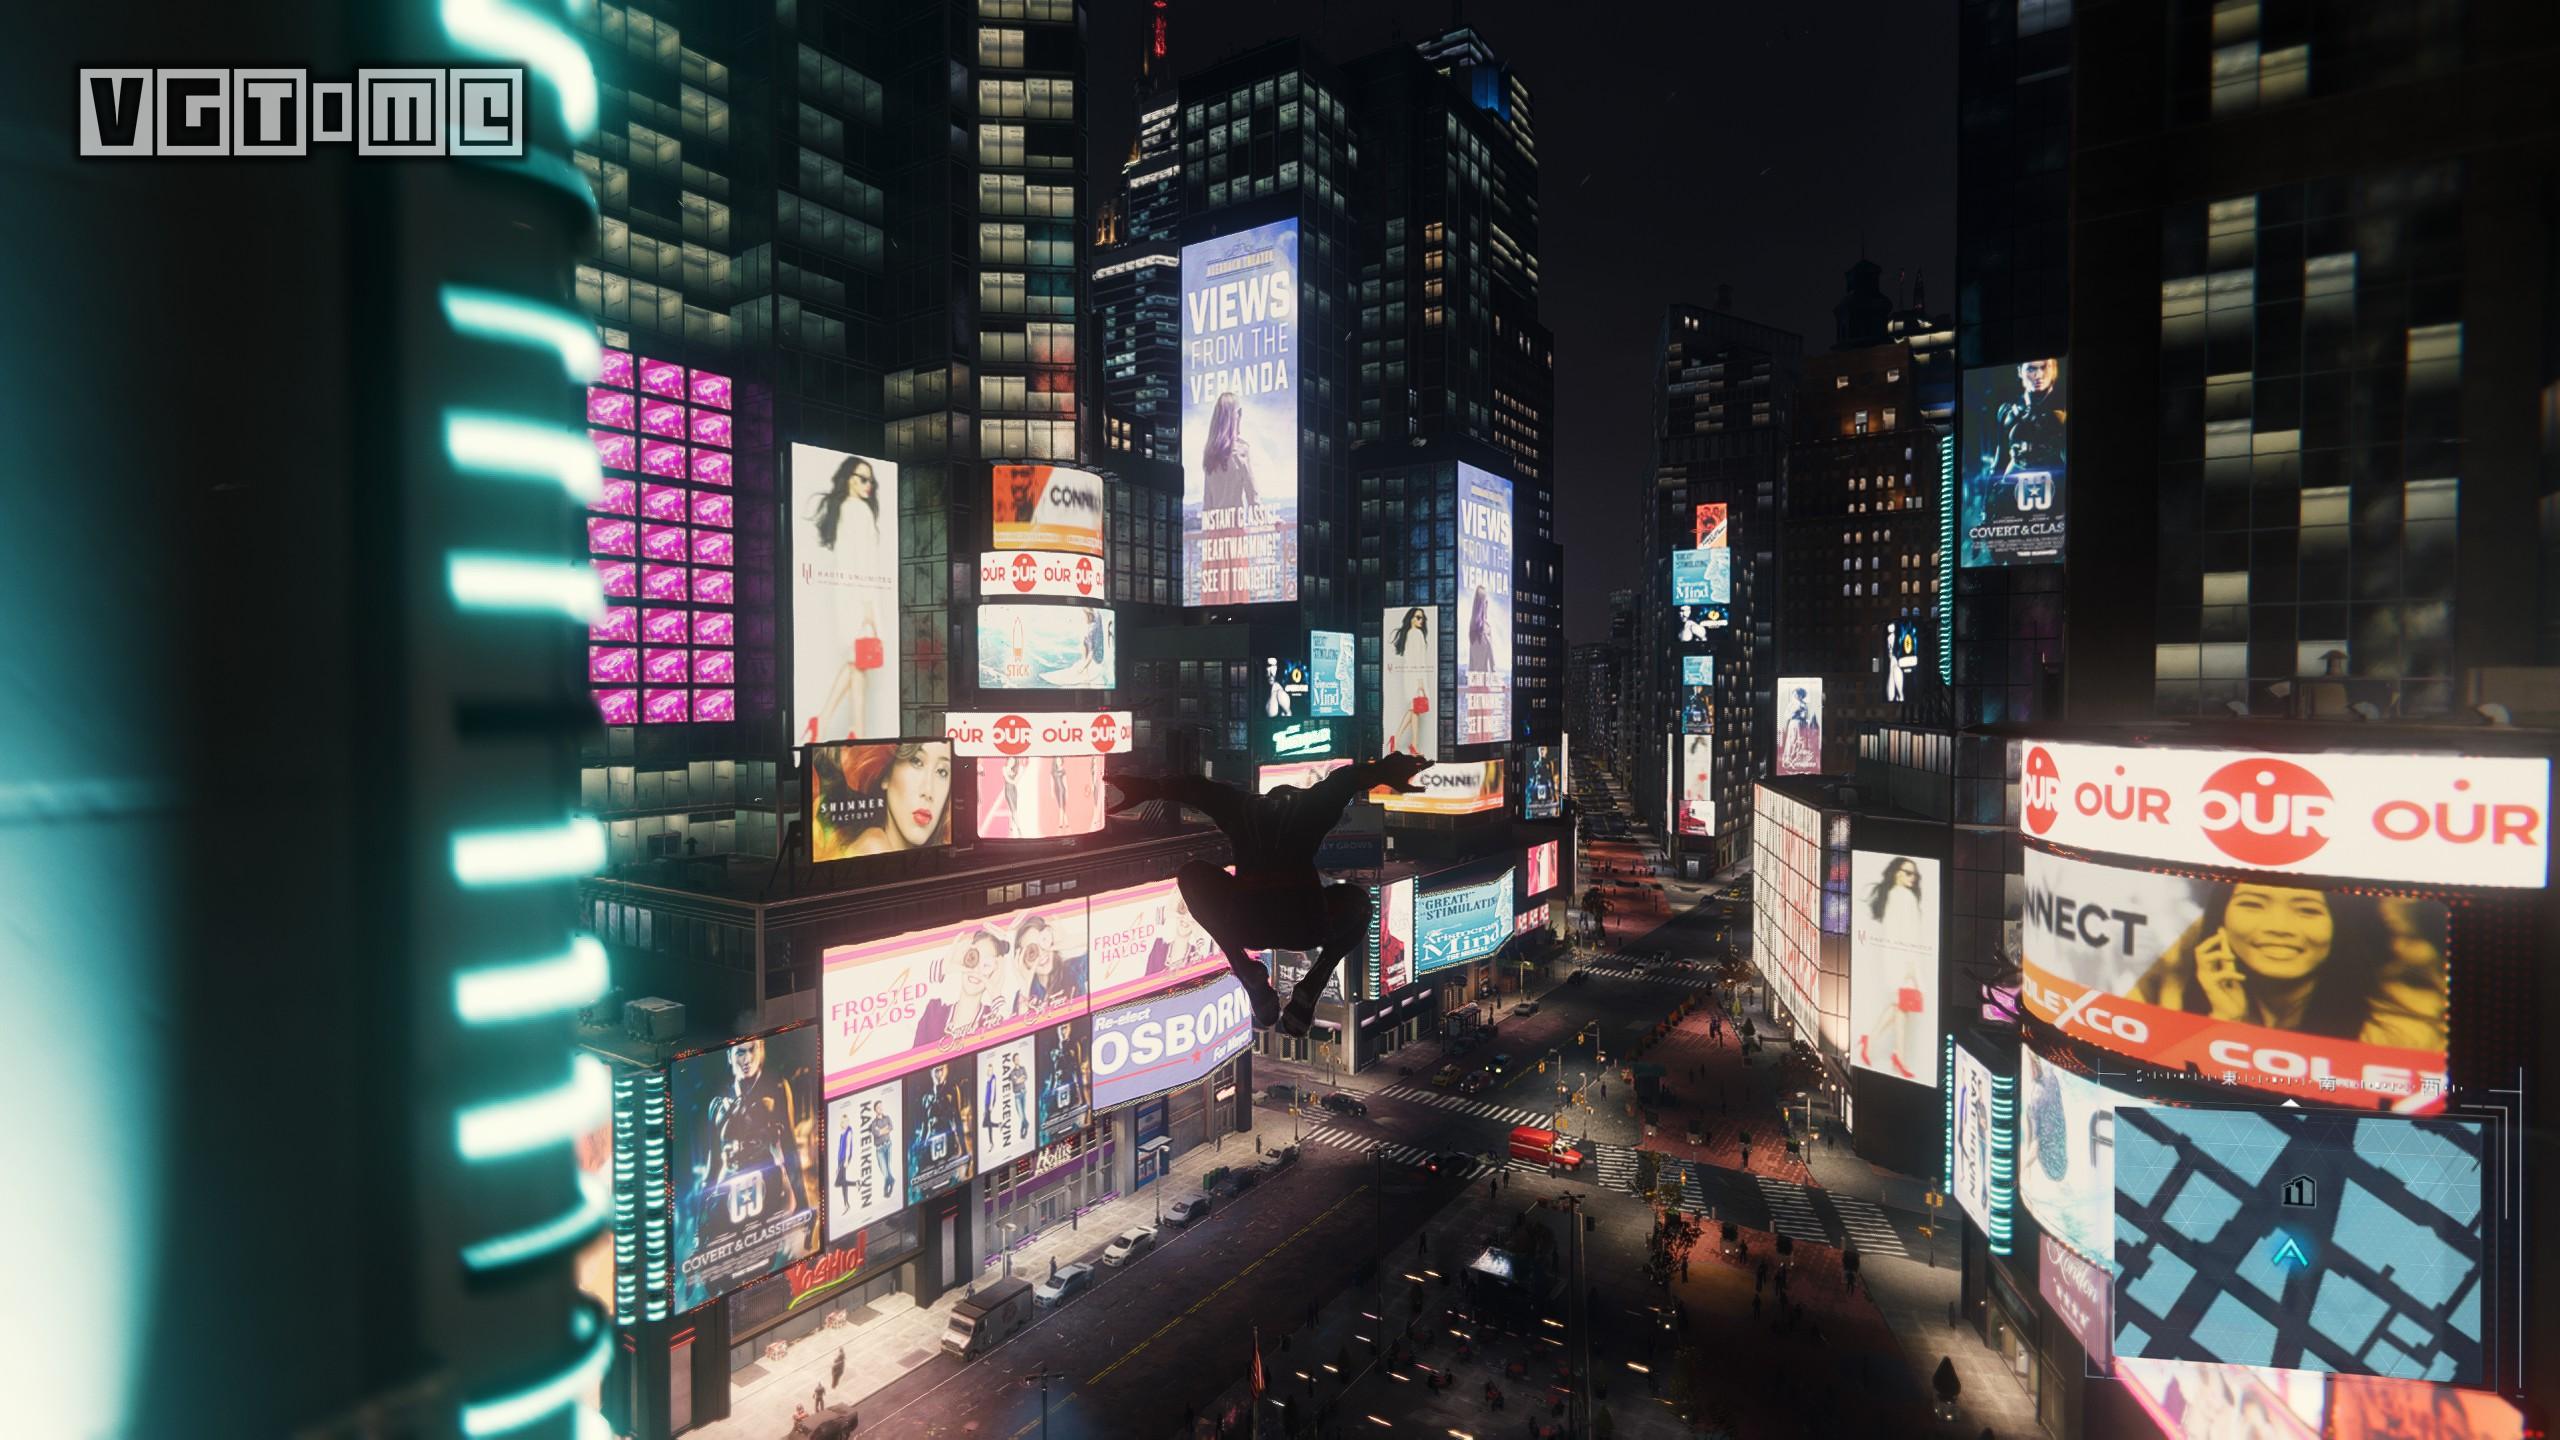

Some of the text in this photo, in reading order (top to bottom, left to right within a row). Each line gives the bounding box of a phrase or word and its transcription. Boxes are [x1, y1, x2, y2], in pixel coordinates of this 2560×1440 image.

[1188, 270, 1290, 335] VIEWS
[1191, 322, 1289, 370] FROM THE
[1190, 359, 1289, 404] VERANDA
[1461, 499, 1509, 545] VIEWS
[1969, 525, 2020, 538] COVERT
[2021, 525, 2030, 535] &
[1044, 560, 1070, 582] OUR
[1463, 540, 1509, 570] FROM THE
[1220, 569, 1230, 592] IT
[1676, 585, 1708, 600] Mind
[1313, 688, 1340, 706] Mind
[948, 720, 983, 743] OUR
[993, 719, 1032, 744] OUR
[1042, 720, 1083, 743] OUR
[1091, 718, 1117, 743] OUR
[820, 798, 885, 813] SHIMMER
[832, 812, 875, 821] FACTORY
[2074, 765, 2172, 825] OUR
[2198, 771, 2335, 838] OUR
[2371, 779, 2540, 846] OUR
[1094, 924, 1155, 951] FROSTED
[1101, 940, 1147, 964] HALOS
[1421, 920, 1500, 961] Mind
[831, 983, 929, 1022] FROSTED
[843, 1003, 917, 1037] HALOS
[1091, 986, 1251, 1076] OSBORN
[1095, 1008, 1151, 1032] Re-elect
[1002, 1053, 1013, 1147] KATE KEVIN
[860, 1100, 873, 1209] KATE KEVIN
[682, 1241, 735, 1274] COVERT
[734, 1240, 744, 1252] &
[743, 1209, 813, 1247] CLASSIFIED
